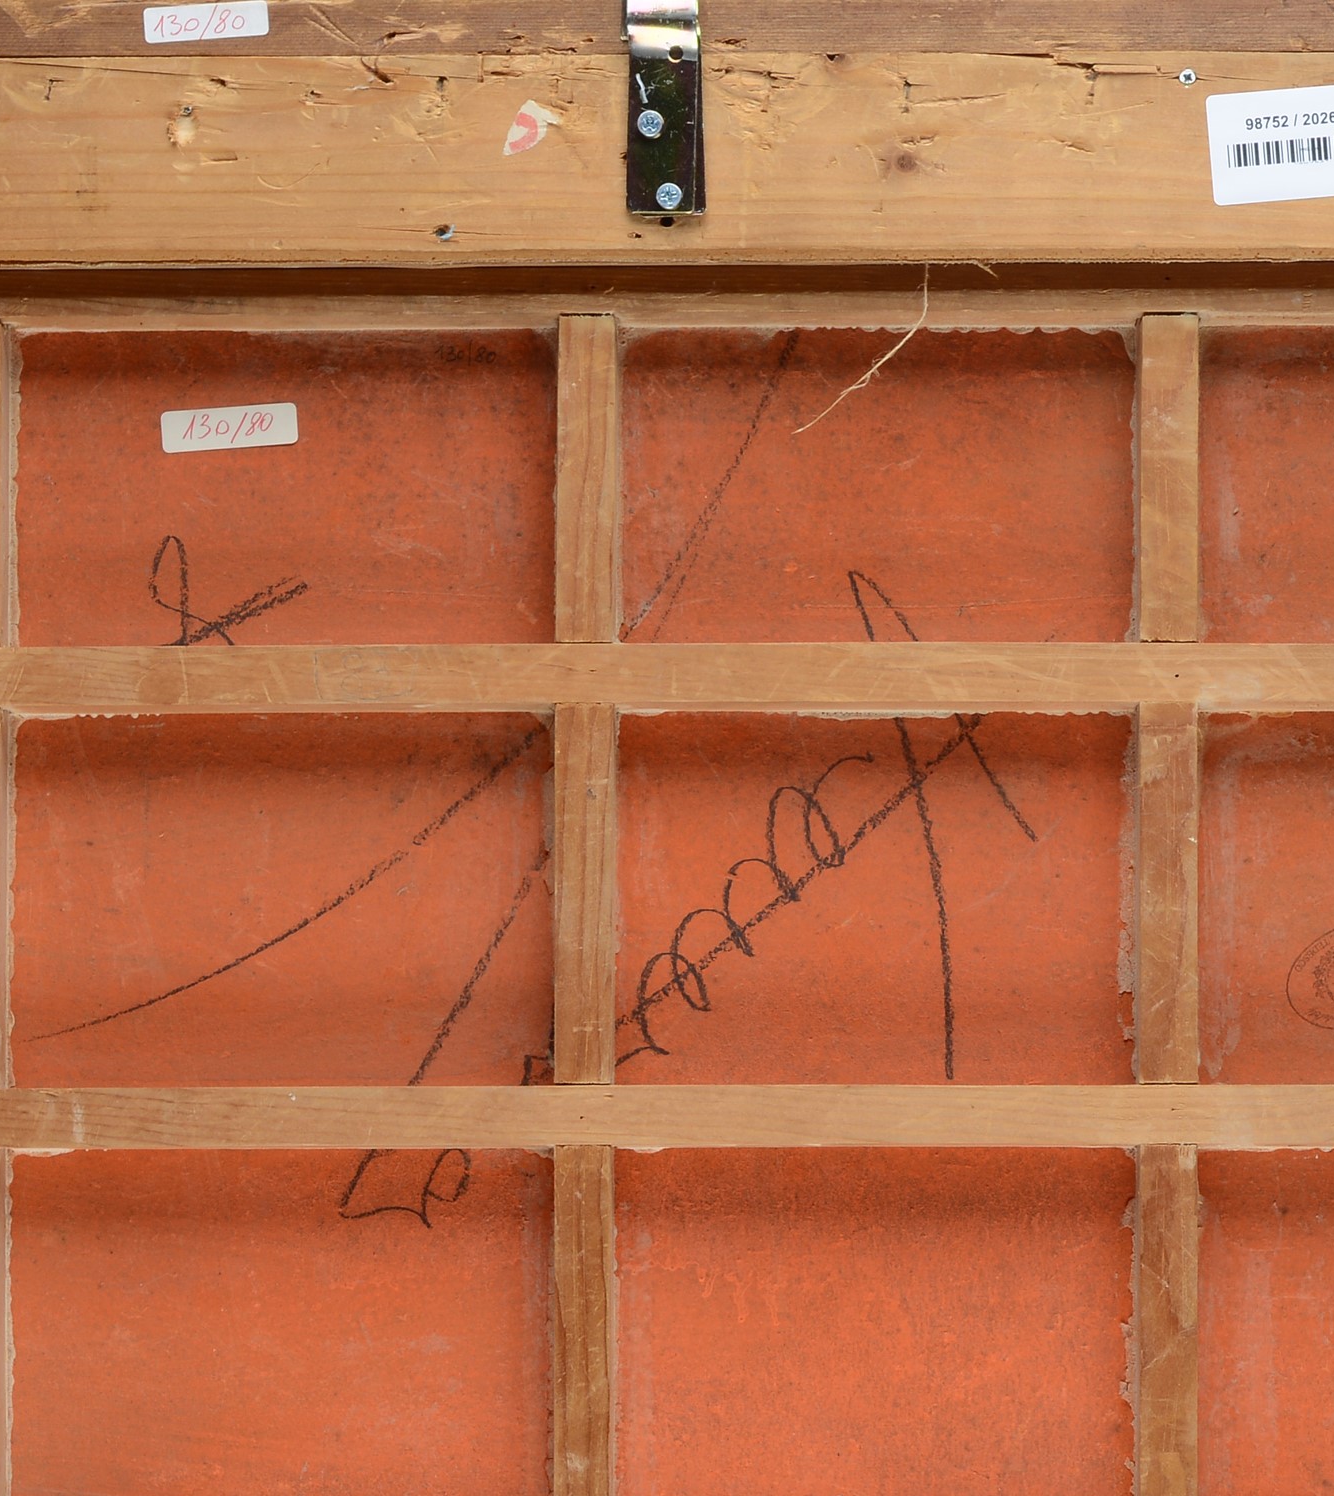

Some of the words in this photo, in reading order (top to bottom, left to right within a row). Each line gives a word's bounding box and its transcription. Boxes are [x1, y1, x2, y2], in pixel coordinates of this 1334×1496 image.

[153, 5, 246, 40] 130/80
[1245, 115, 1289, 130] 98752
[1293, 113, 1299, 127] /
[182, 411, 274, 444] 130/80
